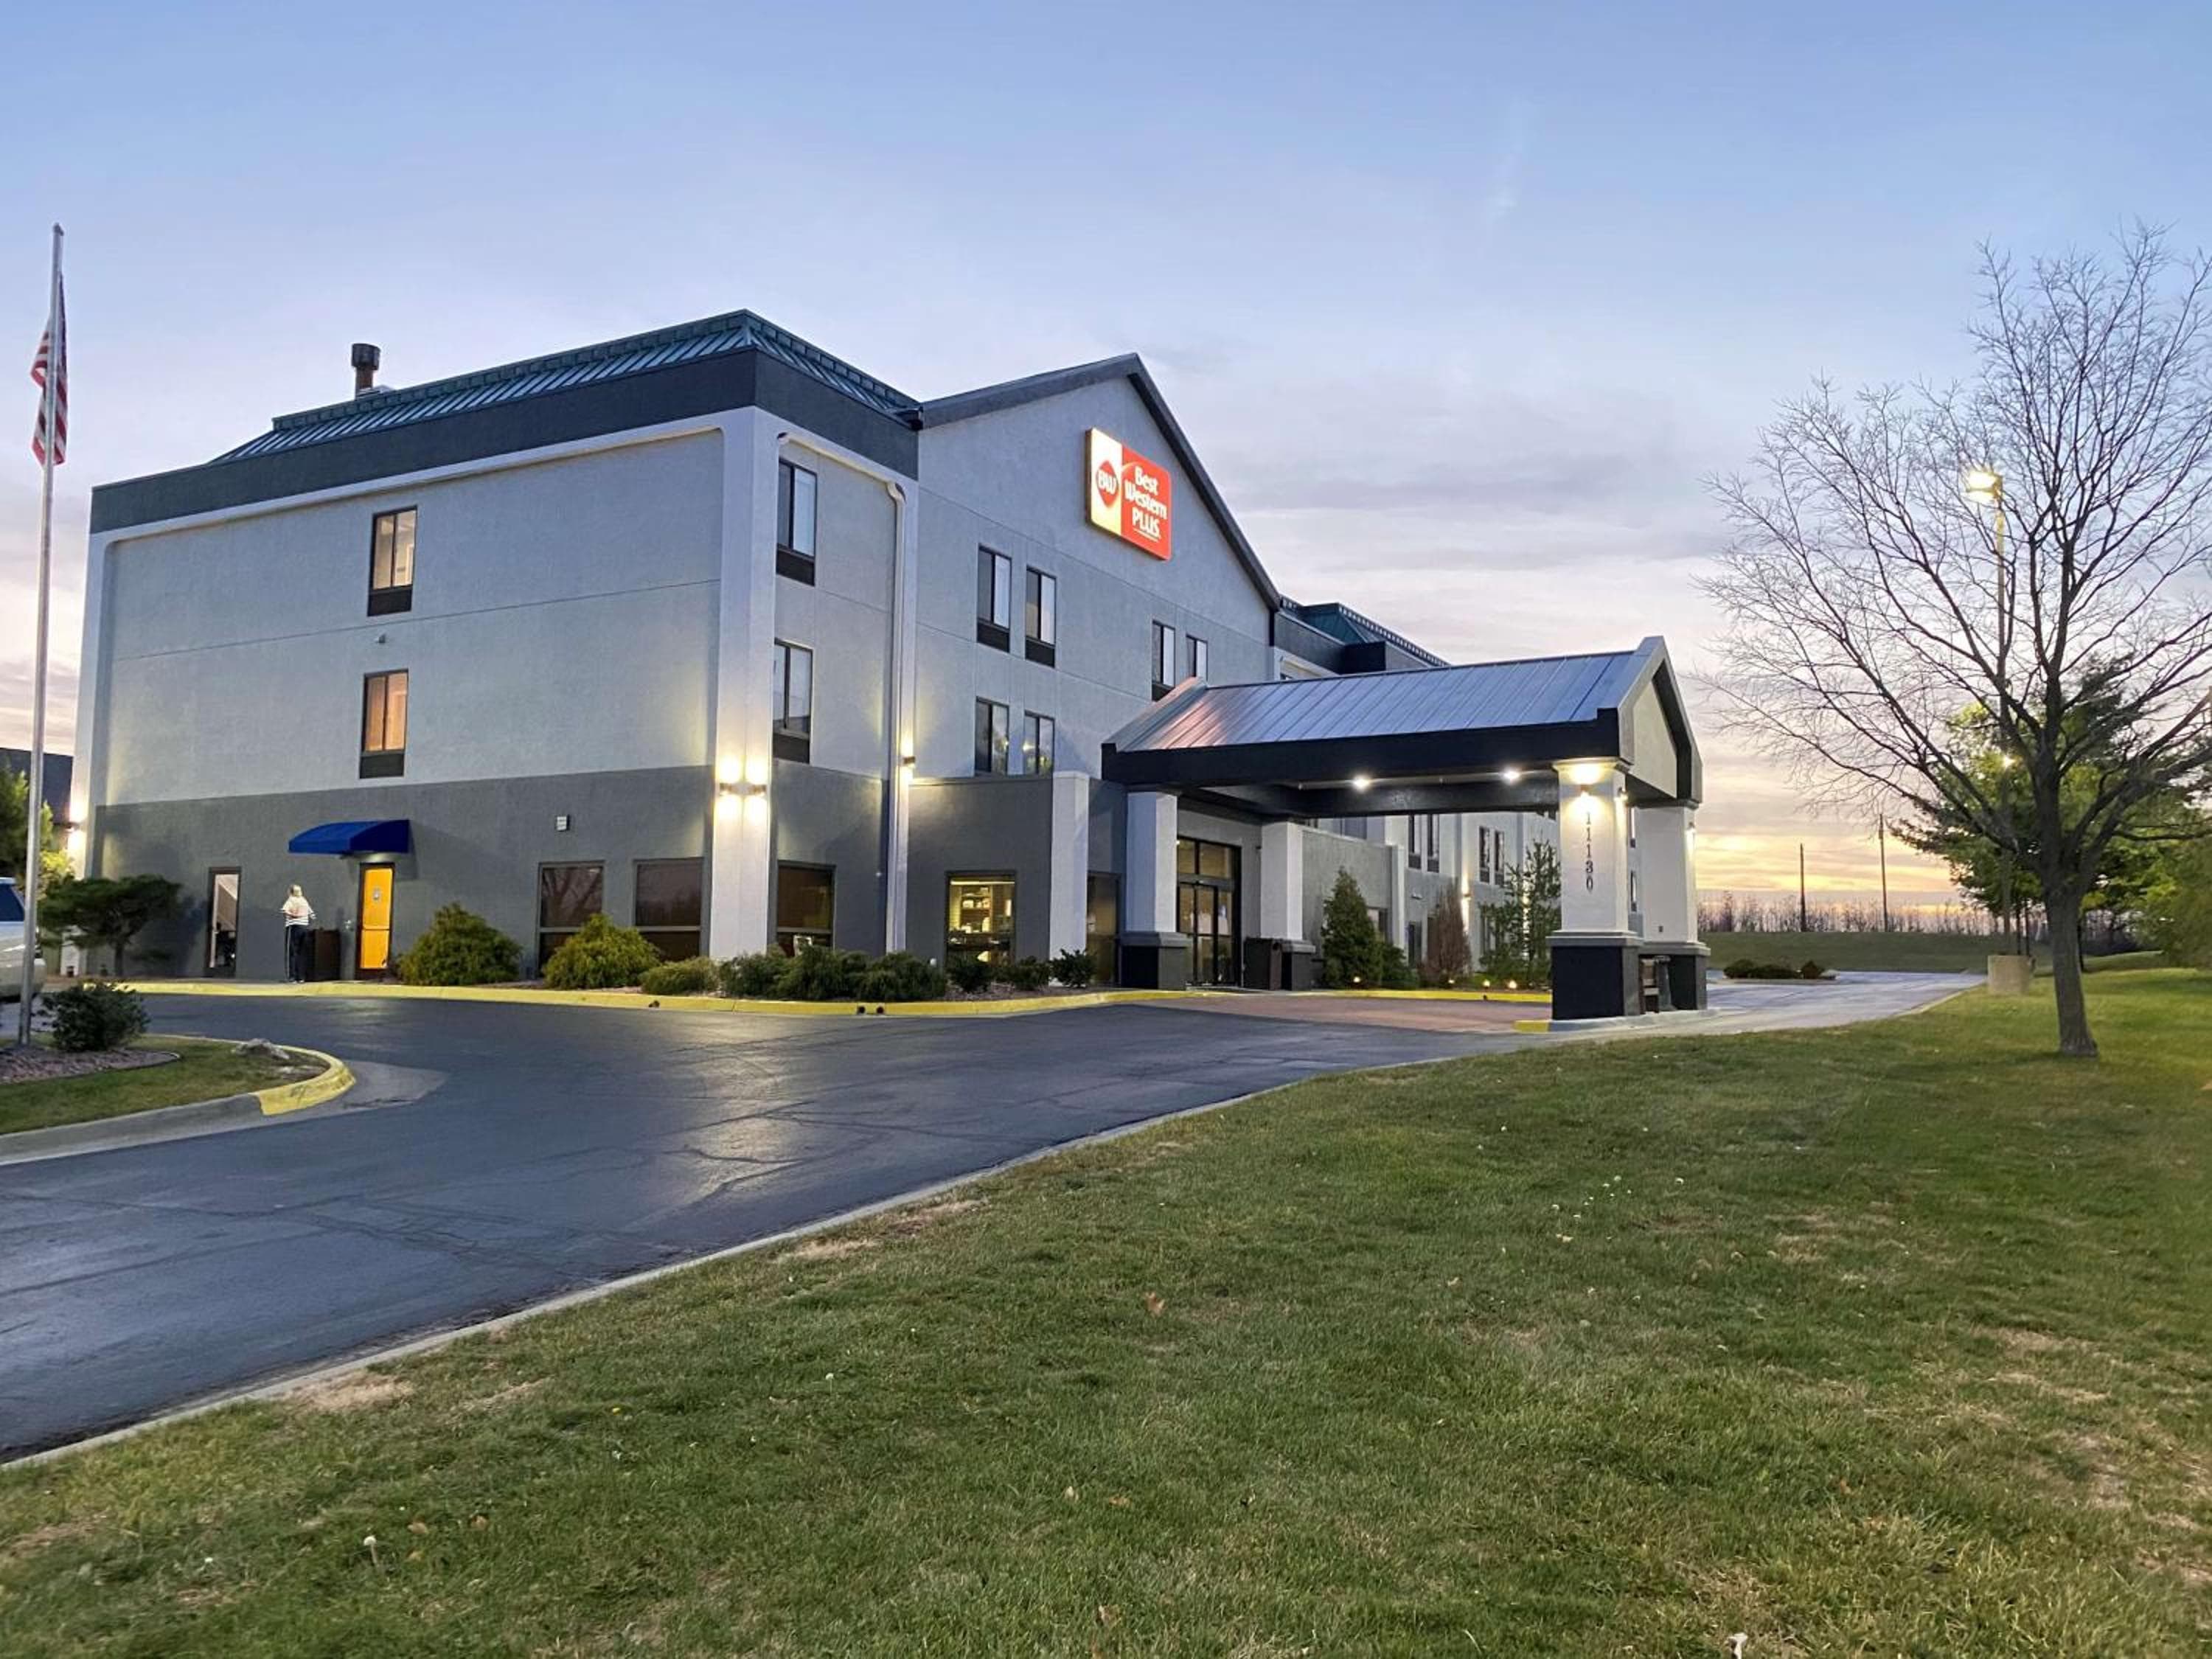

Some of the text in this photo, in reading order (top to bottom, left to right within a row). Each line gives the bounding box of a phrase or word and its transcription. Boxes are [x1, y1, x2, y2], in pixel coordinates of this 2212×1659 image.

[1098, 469, 1117, 495] BW
[1135, 466, 1158, 495] Best
[1124, 479, 1167, 520] Western
[1132, 507, 1161, 538] PLUS
[1585, 812, 1593, 892] 11130
